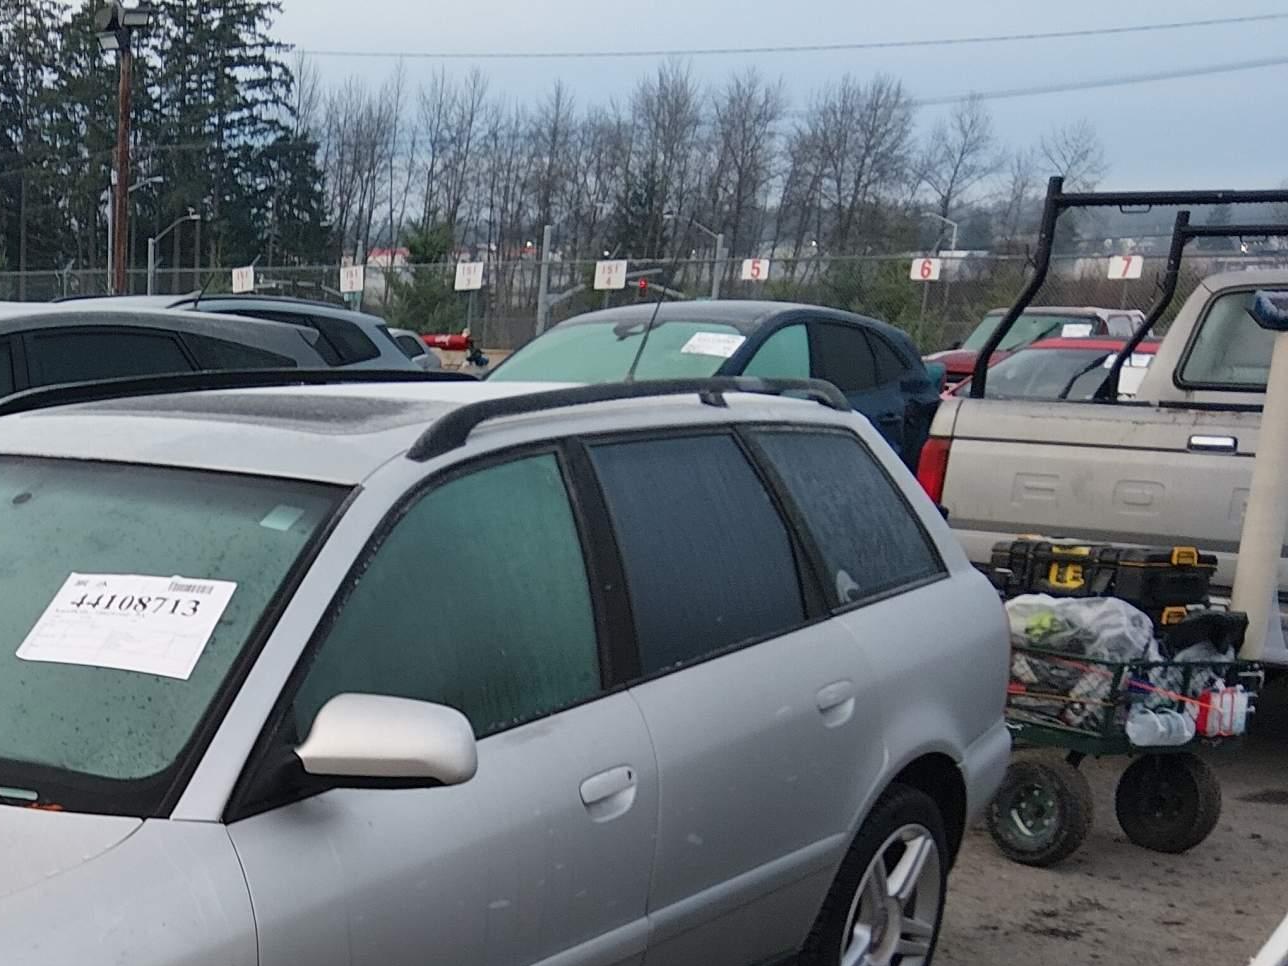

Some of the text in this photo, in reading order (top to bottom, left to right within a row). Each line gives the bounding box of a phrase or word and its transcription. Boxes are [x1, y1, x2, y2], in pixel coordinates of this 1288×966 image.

[751, 259, 761, 278] 5
[920, 259, 932, 279] 6
[1122, 256, 1132, 277] 7
[71, 593, 201, 617] 44108713
